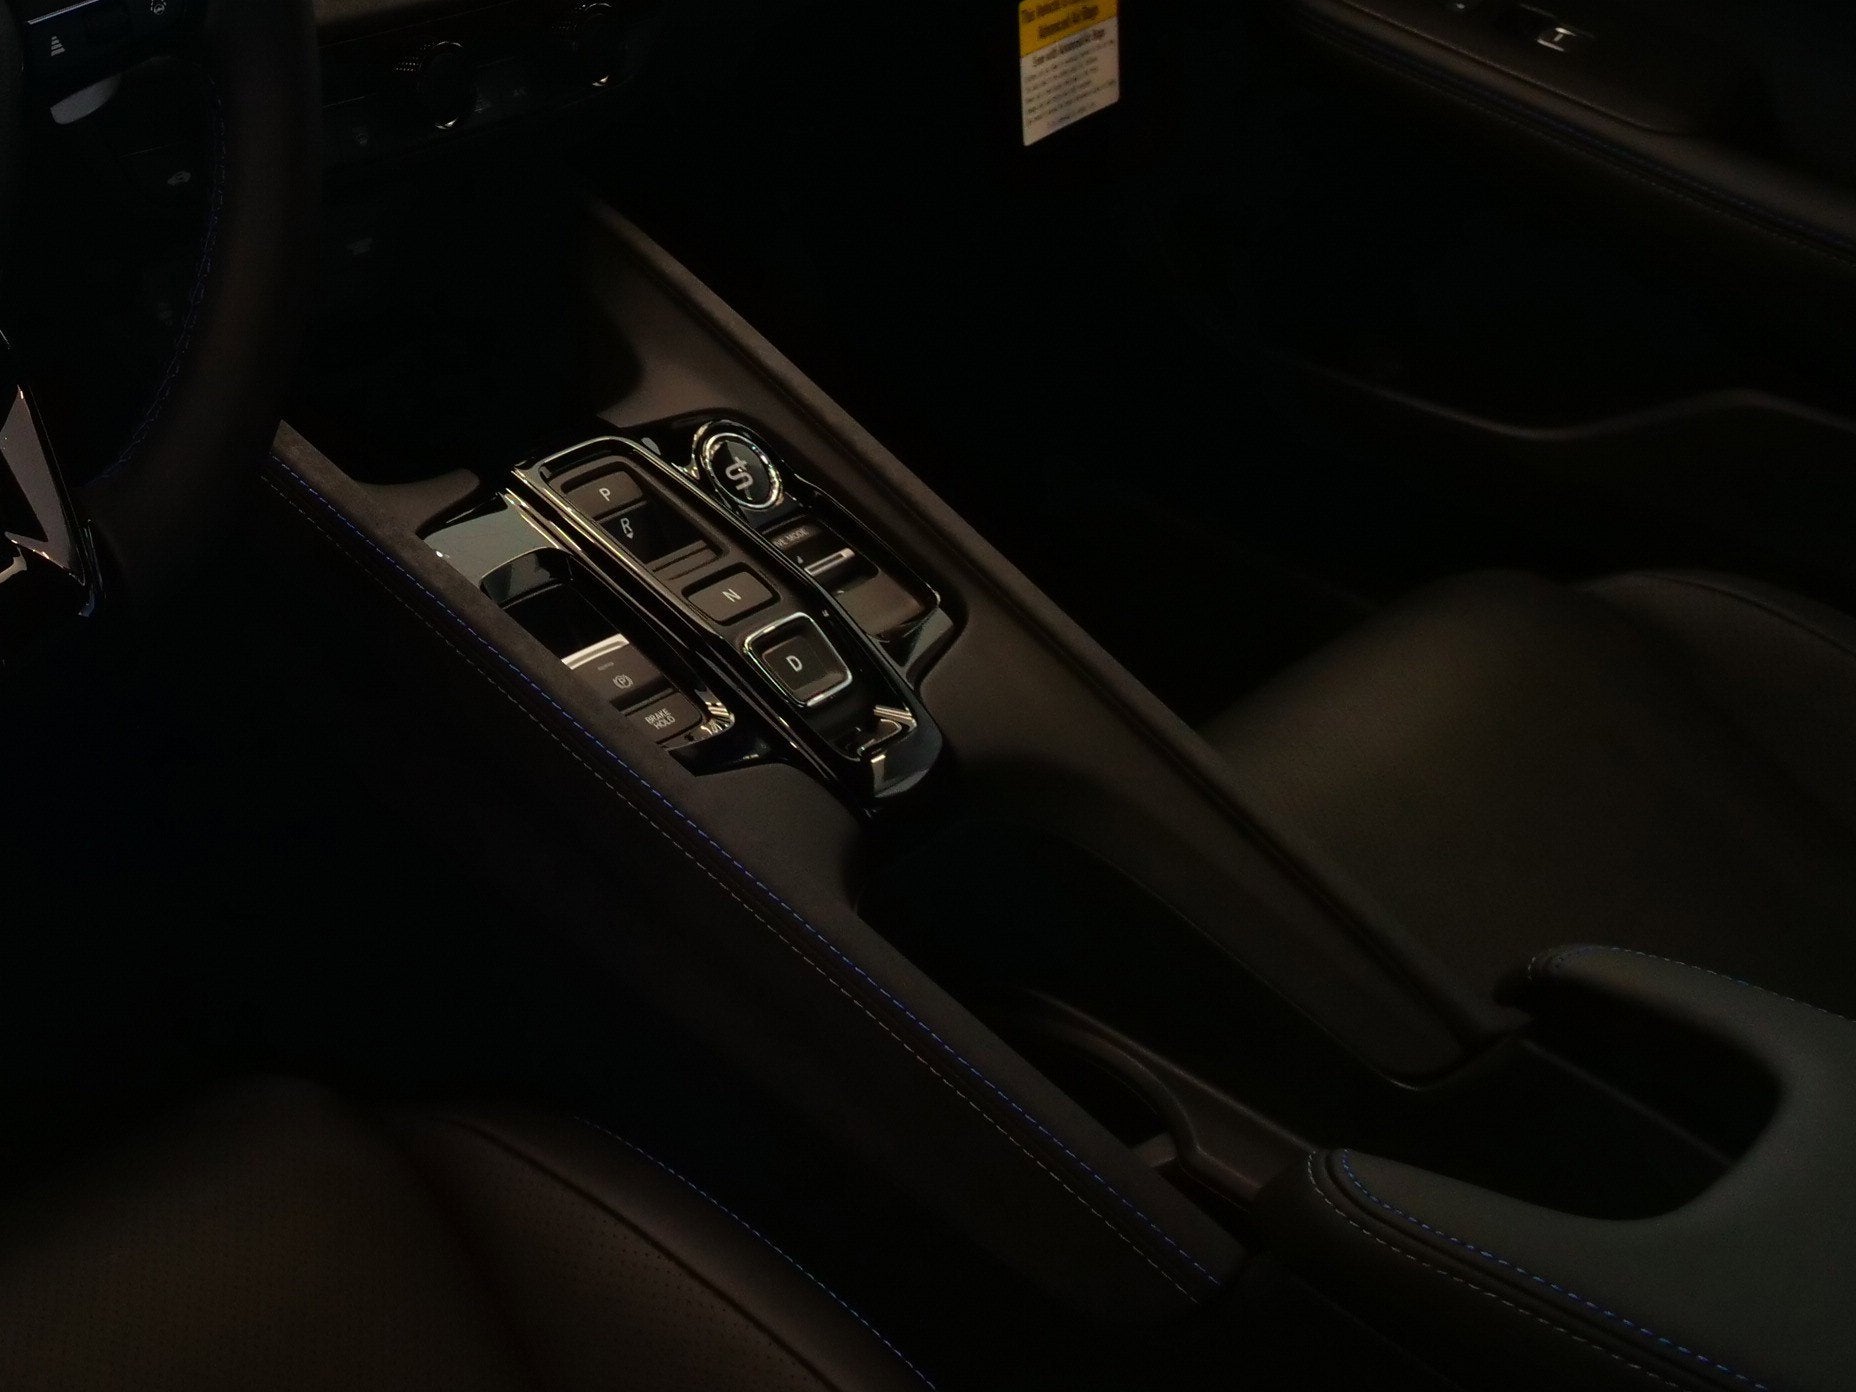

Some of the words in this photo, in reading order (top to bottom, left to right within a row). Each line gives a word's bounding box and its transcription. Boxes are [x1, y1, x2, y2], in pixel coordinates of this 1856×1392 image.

[598, 487, 611, 502] P
[721, 588, 742, 603] N
[785, 654, 803, 672] D
